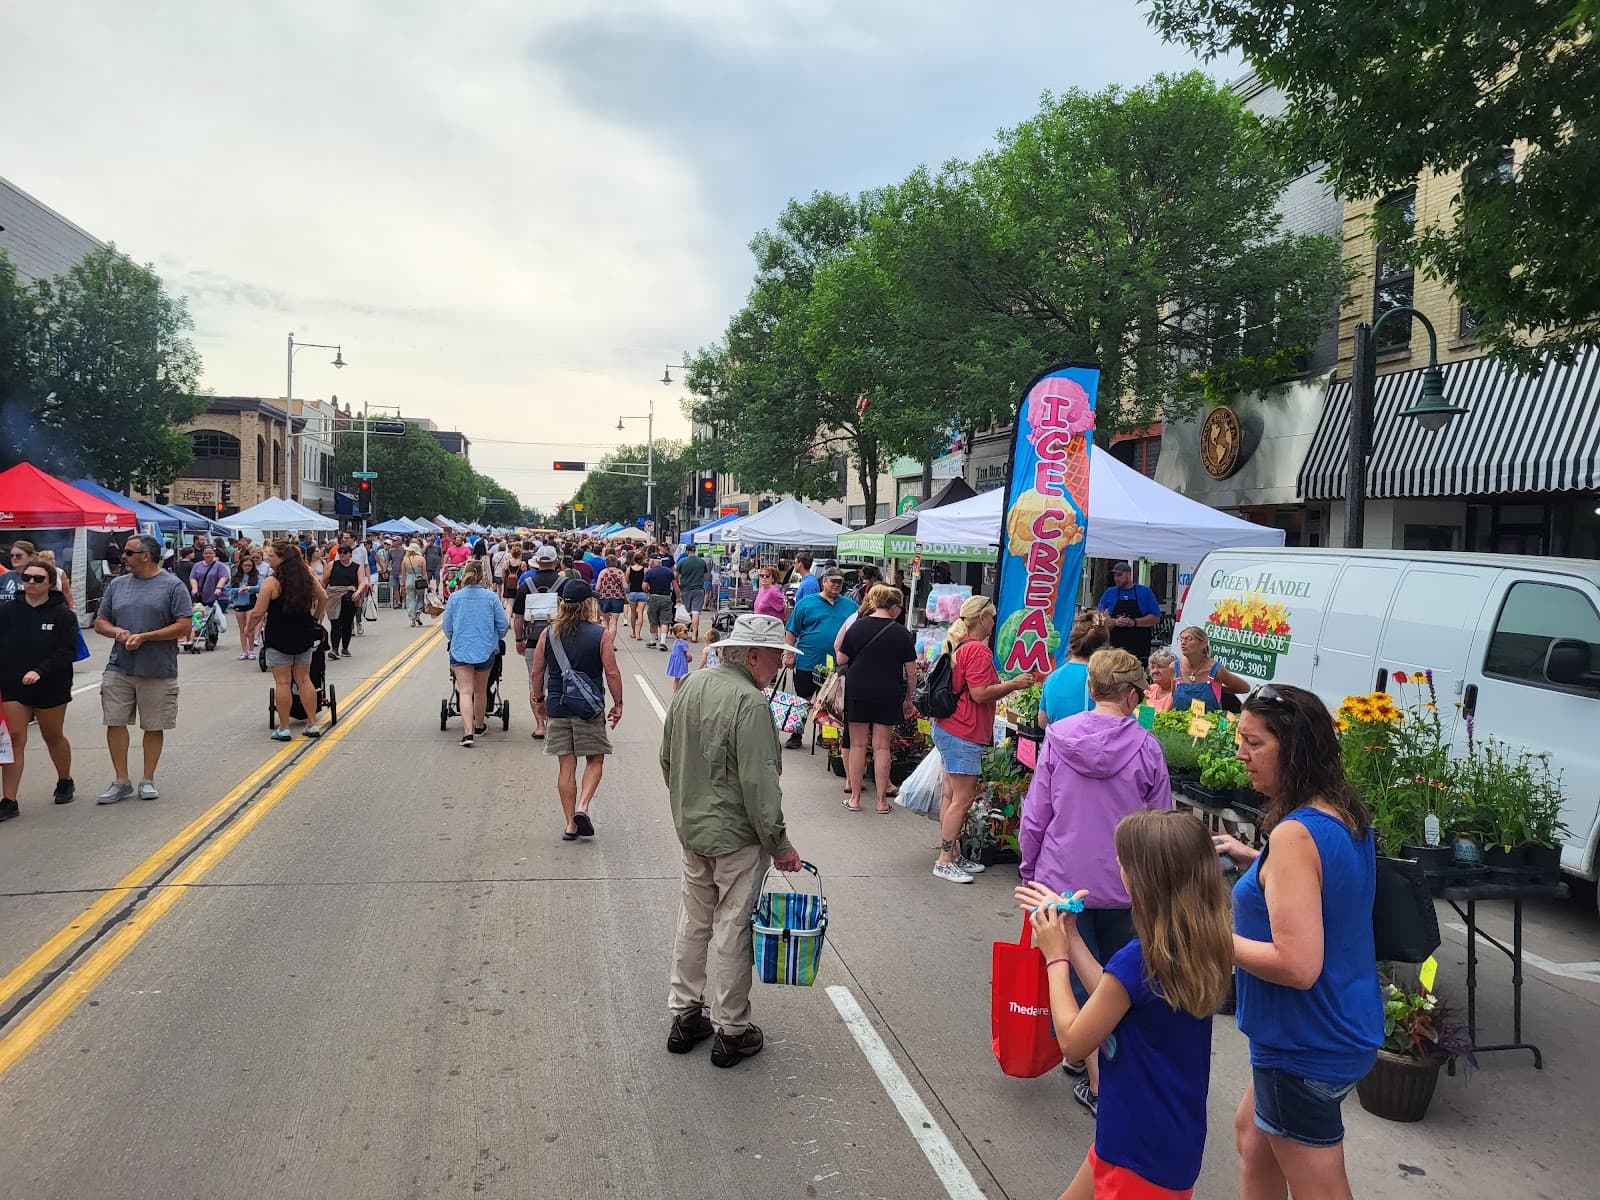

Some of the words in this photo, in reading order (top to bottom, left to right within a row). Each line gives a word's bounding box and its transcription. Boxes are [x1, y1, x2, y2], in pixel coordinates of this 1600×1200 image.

[1035, 395, 1070, 498] ICE
[972, 546, 982, 556] &
[1004, 508, 1065, 673] CREAM
[1210, 569, 1253, 593] GREEN
[1254, 572, 1312, 598] HANDEL
[1205, 624, 1287, 652] GREENHOUSE
[1221, 645, 1232, 656] Hwy
[1231, 648, 1237, 656] N
[1239, 650, 1263, 662] Appleton,
[1263, 654, 1272, 663] WI
